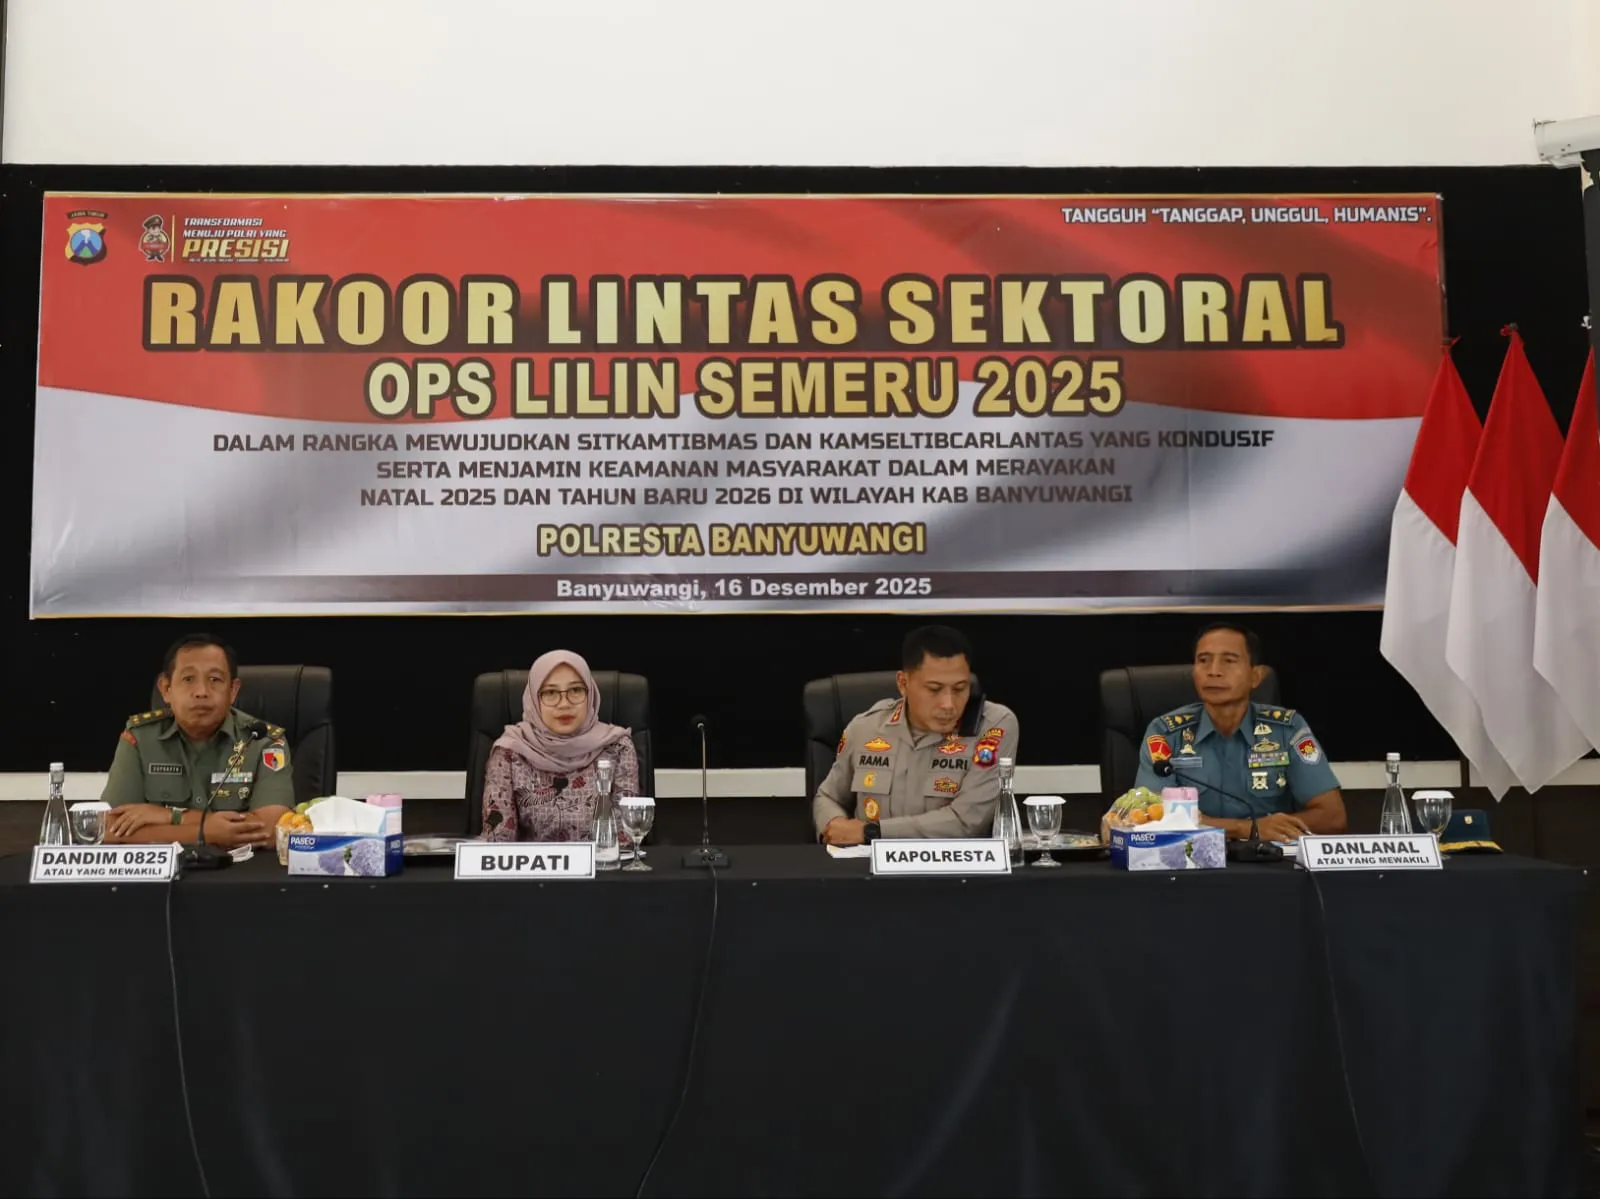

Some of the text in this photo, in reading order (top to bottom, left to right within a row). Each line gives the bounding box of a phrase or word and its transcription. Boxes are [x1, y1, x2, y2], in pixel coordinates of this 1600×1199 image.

[184, 217, 263, 226] TRANSFORMASI
[1061, 207, 1147, 223] TANGGUH
[1251, 207, 1329, 224] UNGGUL,
[182, 229, 287, 238] MENUJU POLRI YANG
[182, 239, 289, 258] PRESISI
[147, 277, 1340, 348] RAKOOR LINTAS SEKTORAL
[366, 358, 1123, 416] OPS LILIN SEMERU 2025
[213, 430, 1275, 452] DALAM RANGKA MEWUJUDKAN SITKAMTIBMAS DAN KAMSELTIBCARLANTAS YANG KONDUSIF
[376, 458, 1116, 479] SERTA MENJAMIN KEAMANAN MASYARAKAT DALAM MERAYAKAN
[359, 485, 1133, 506] NATAL 2025 DAN TAHUN BARU 2026 DI WILAYAH KAB BANYUWANGI
[538, 524, 926, 555] POLRESTA BANYUWANGI
[556, 577, 933, 601] Banyuwangi, 16 Desember 2025
[859, 755, 890, 768] RAMA
[931, 758, 968, 771] POLRI
[290, 836, 316, 846] PASEO
[1130, 833, 1156, 842] PASEO
[1320, 841, 1420, 855] DANLANAL
[42, 851, 168, 866] DANDIM 0825
[480, 854, 570, 872] BUPATI
[884, 849, 997, 864] KAPOLRESTA
[1316, 856, 1430, 866] ATAU YANG MEWAKILI
[43, 866, 163, 877] ATAU YANG MEWAKILI
